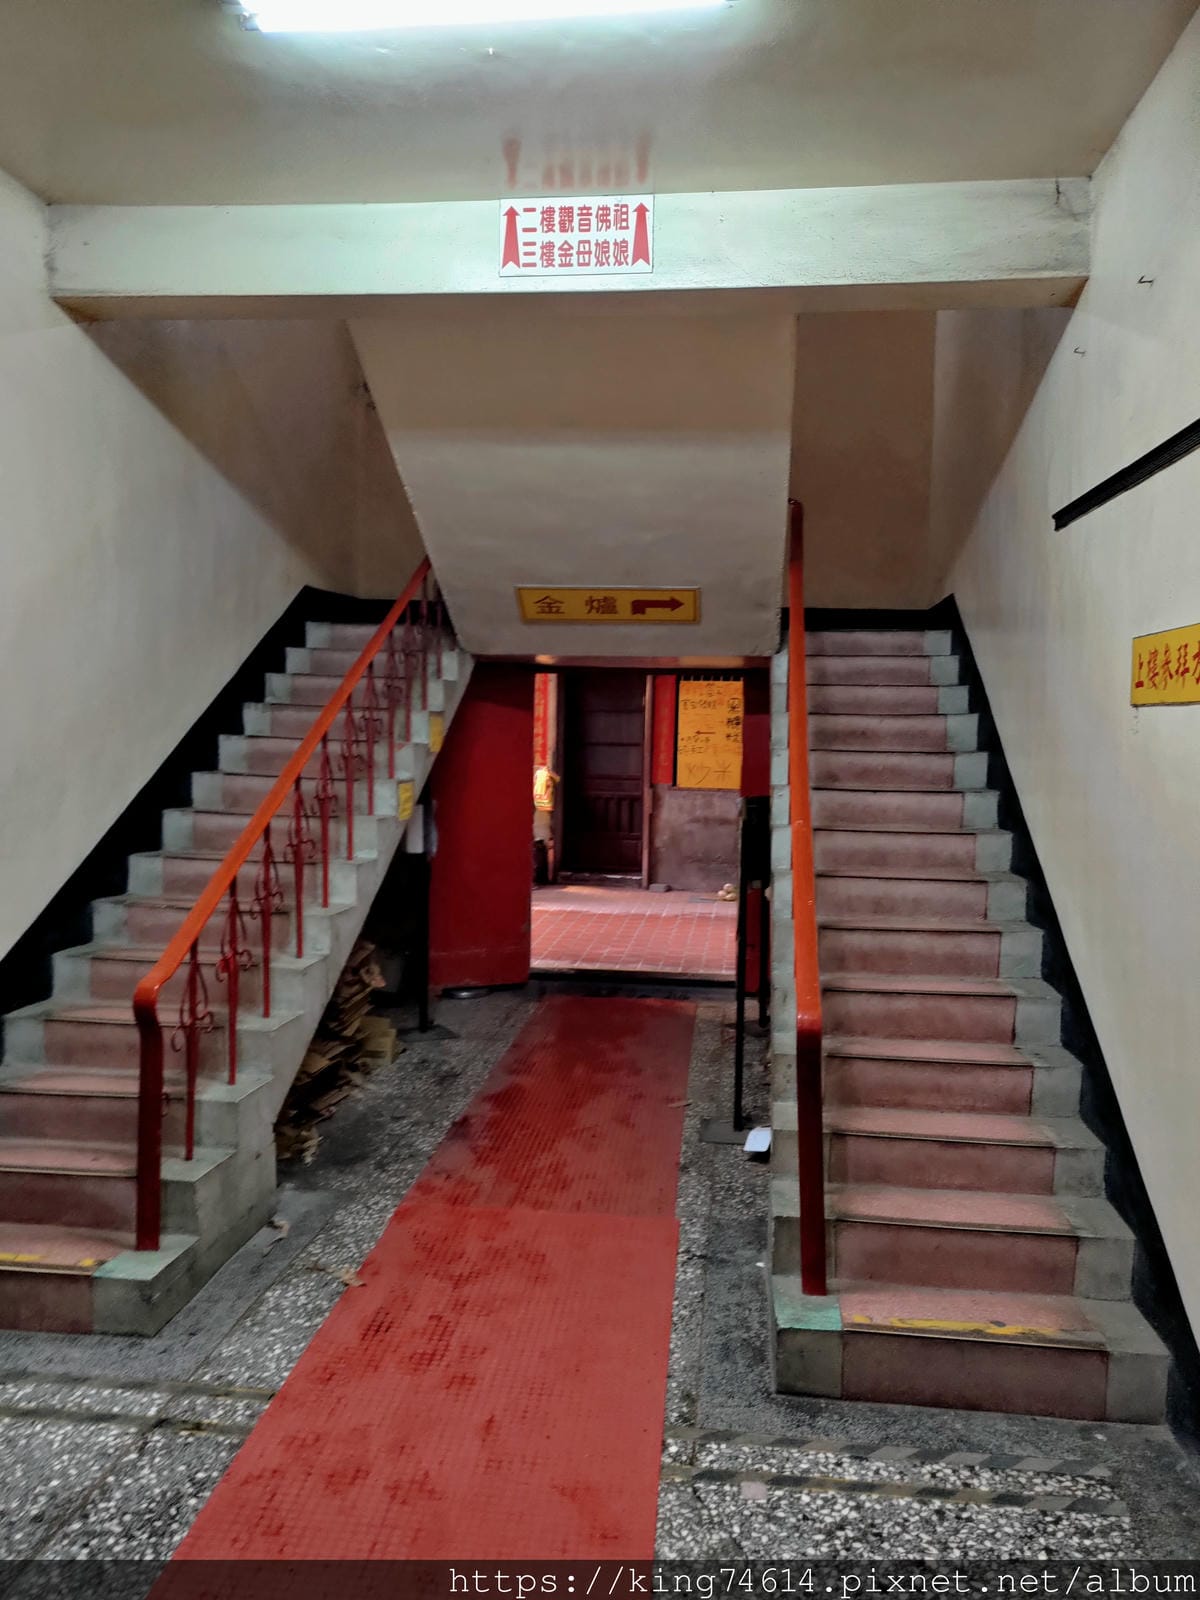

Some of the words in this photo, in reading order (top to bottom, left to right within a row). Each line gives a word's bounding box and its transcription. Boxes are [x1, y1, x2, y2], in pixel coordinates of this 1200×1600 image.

[522, 204, 630, 233] 二樓觀音佛祖
[522, 239, 630, 268] 三樓金母娘娘
